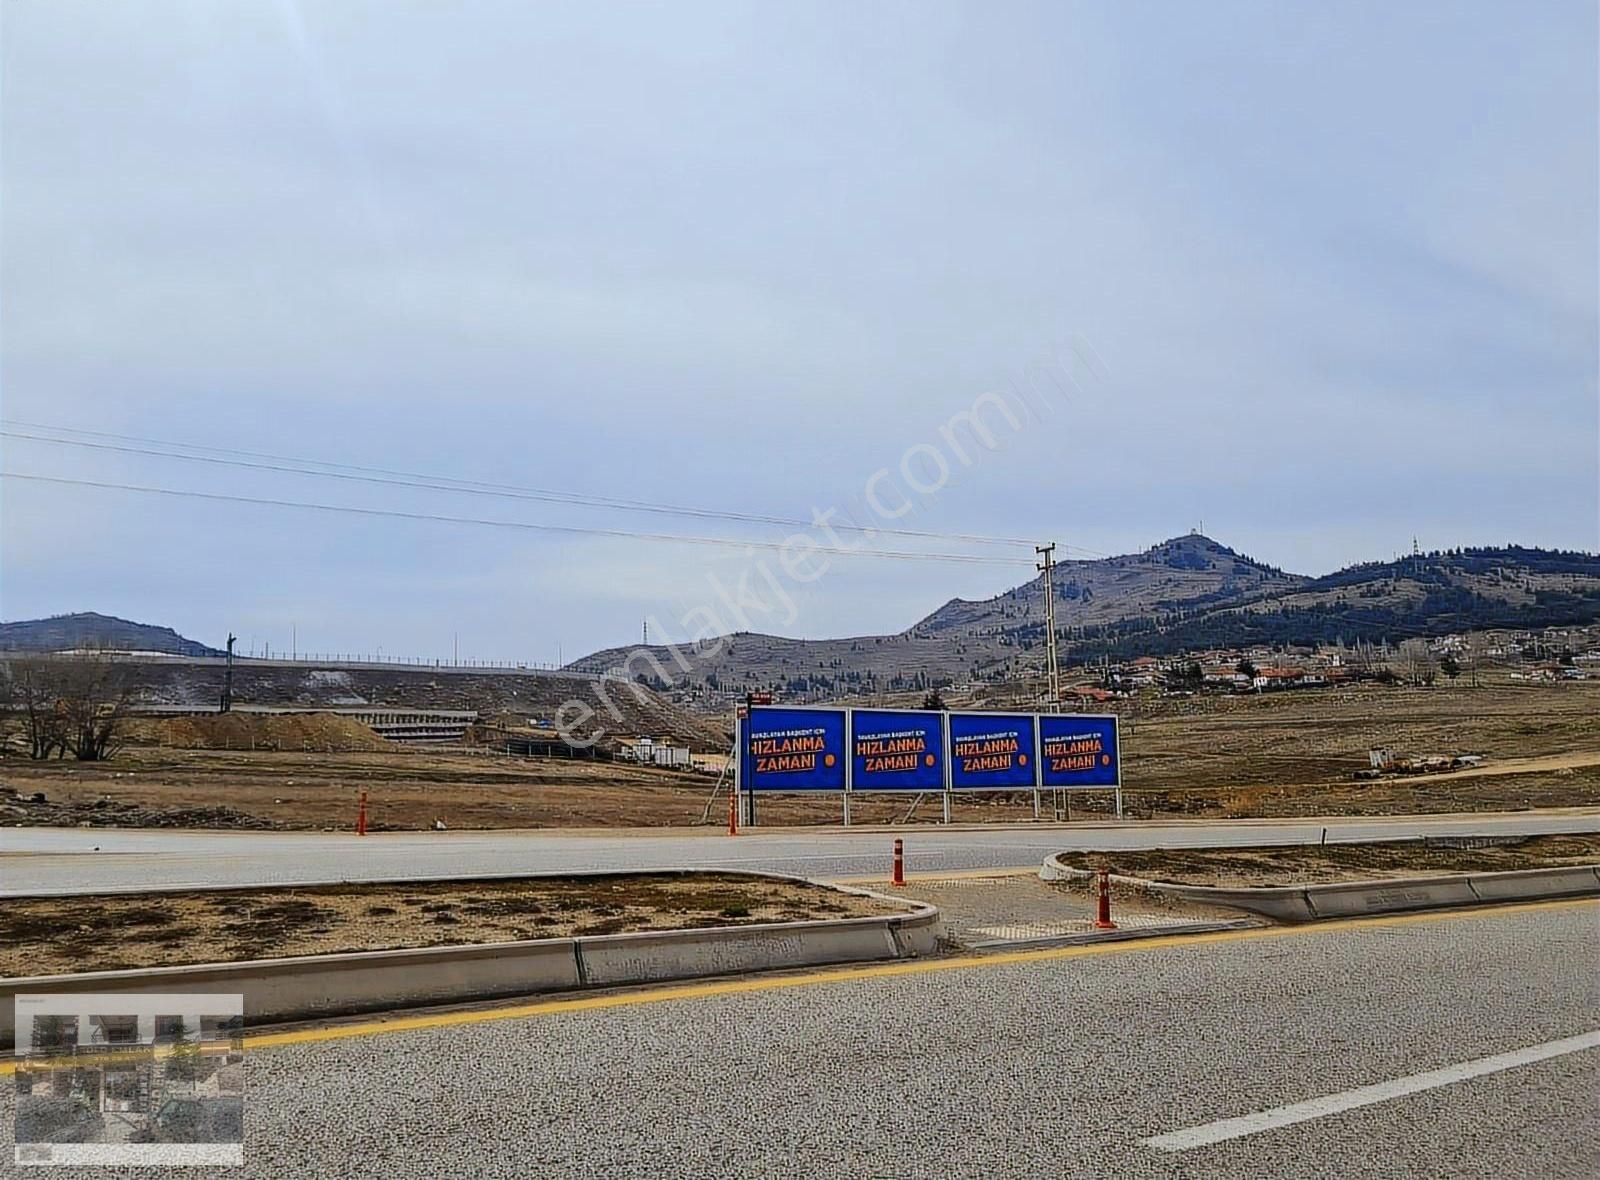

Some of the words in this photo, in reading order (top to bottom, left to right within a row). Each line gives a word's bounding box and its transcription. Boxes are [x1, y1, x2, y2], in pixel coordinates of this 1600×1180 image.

[751, 736, 825, 755] HIZLANMA
[857, 737, 926, 756] HIZLANMA
[955, 738, 1018, 757] HIZLANMA
[1044, 739, 1102, 757] HIZLANMA
[756, 754, 816, 772] ZAMANI
[865, 754, 918, 772] ZAMANI
[963, 755, 1012, 772] ZAMANI
[1052, 755, 1096, 771] ZAMANI
